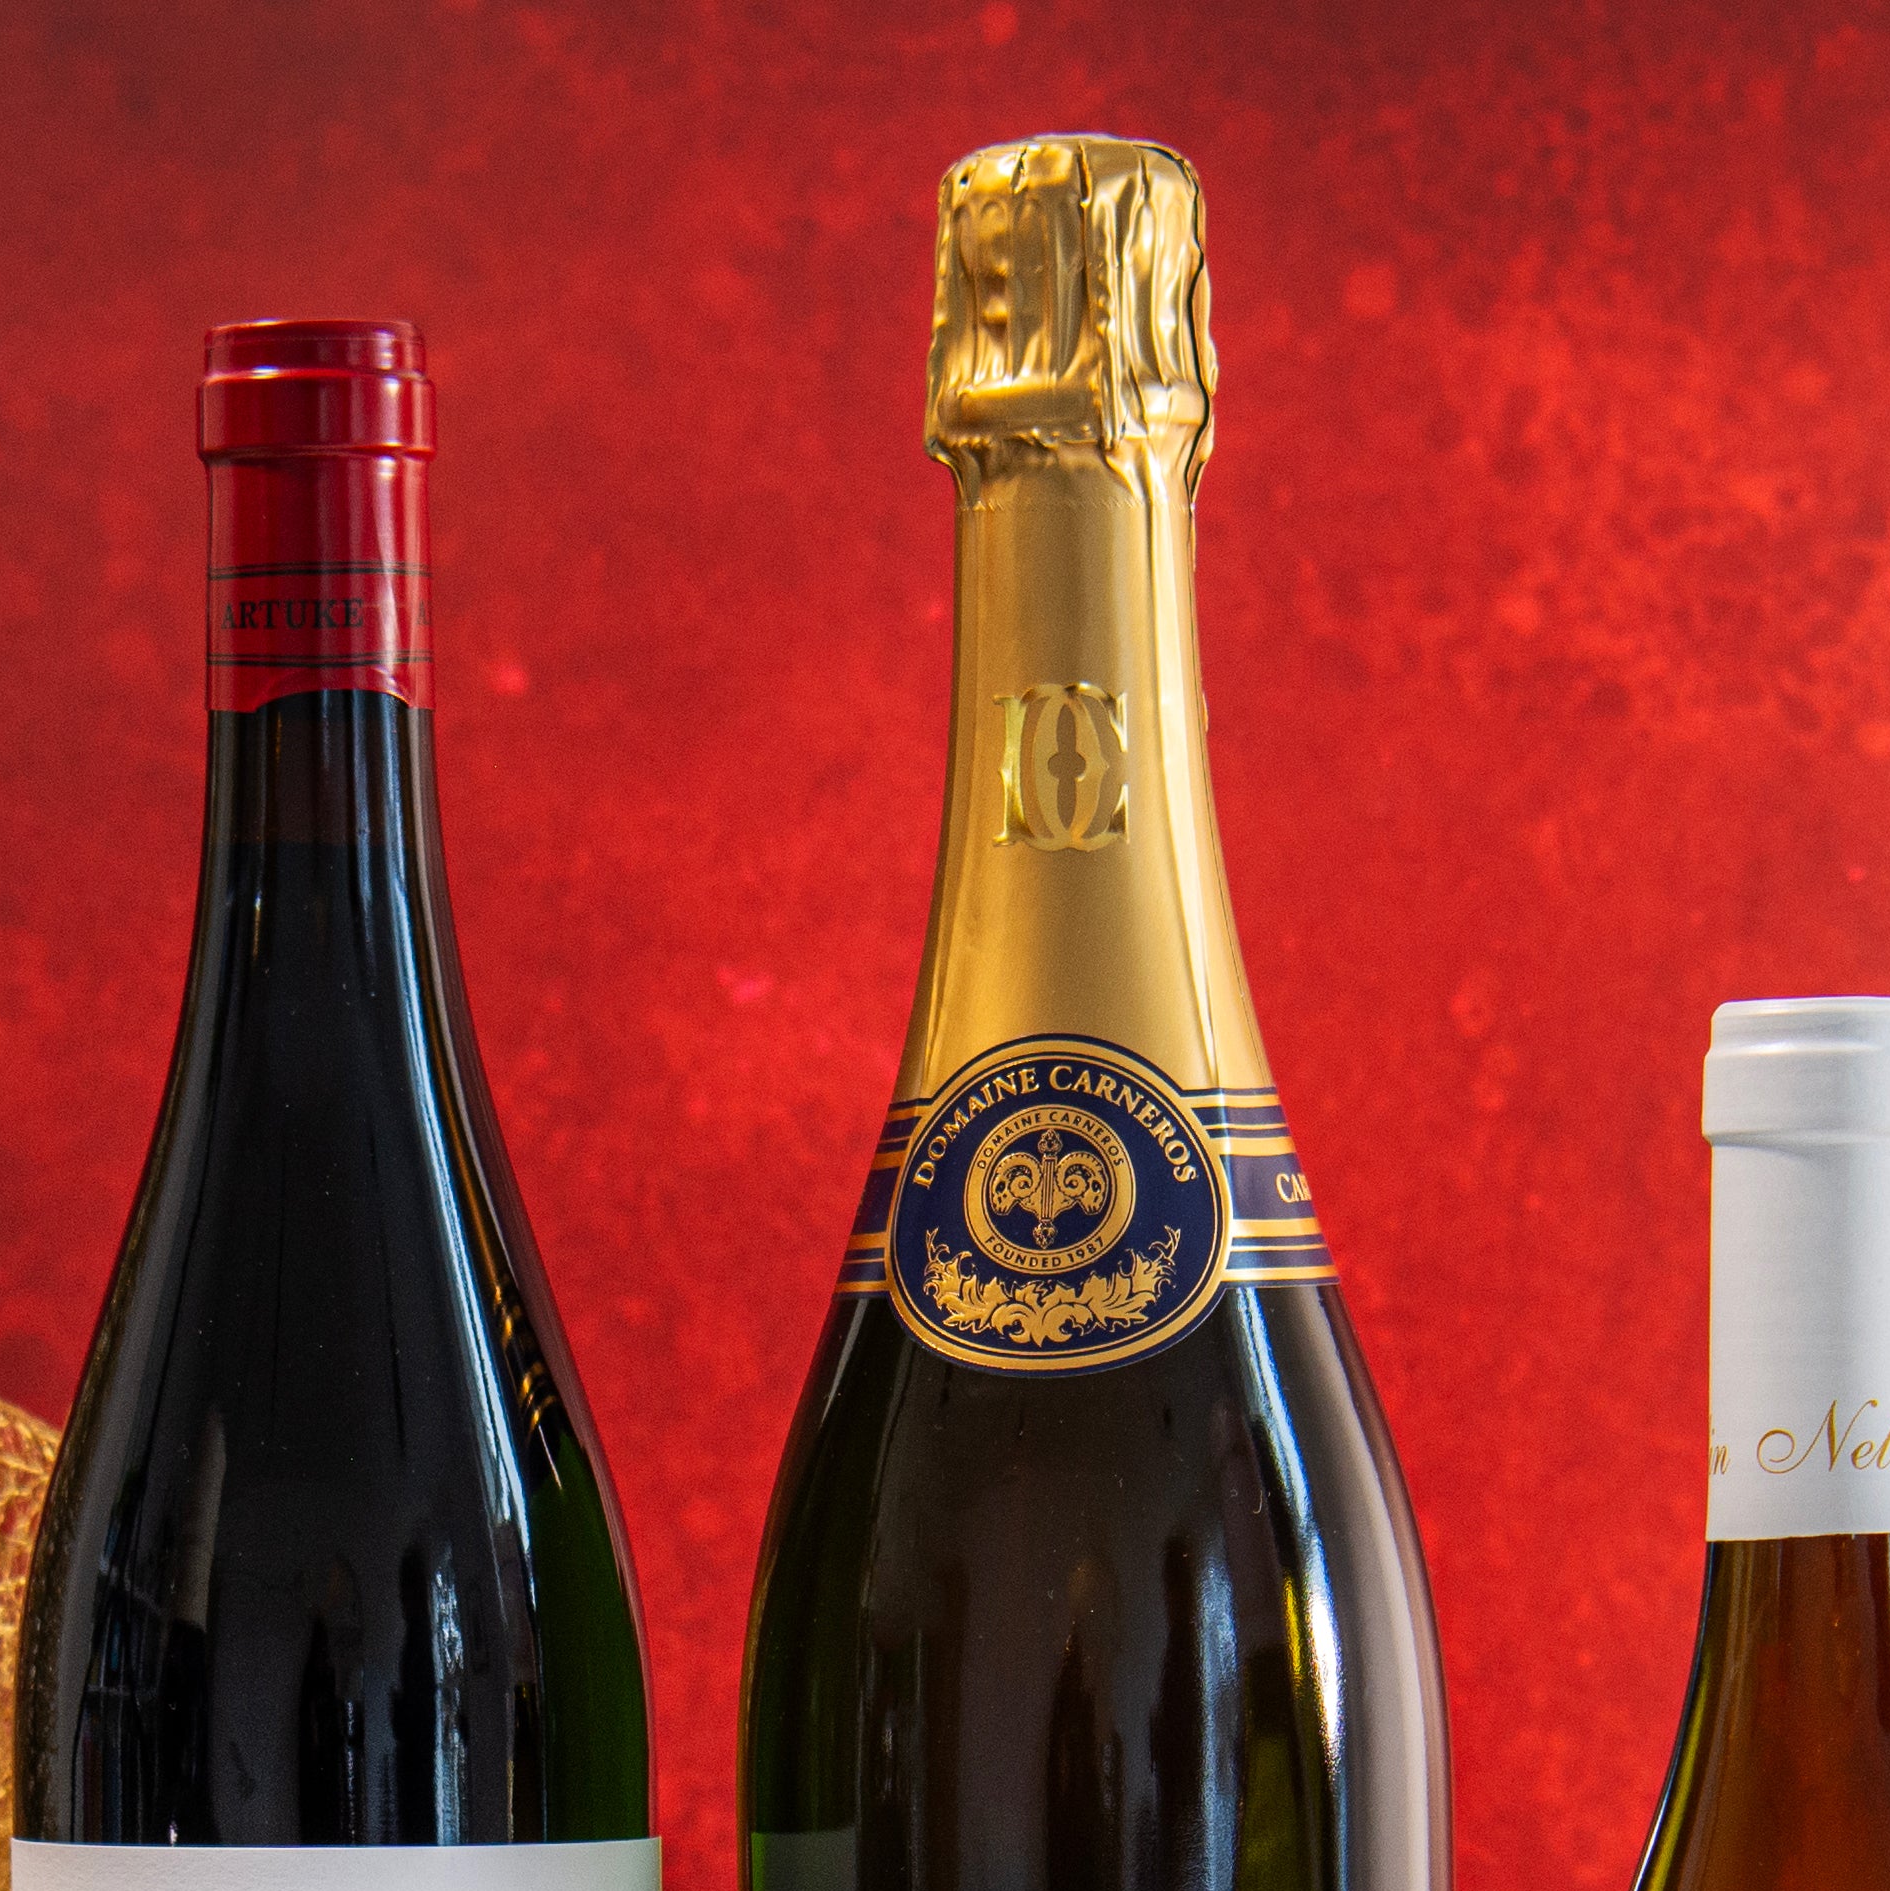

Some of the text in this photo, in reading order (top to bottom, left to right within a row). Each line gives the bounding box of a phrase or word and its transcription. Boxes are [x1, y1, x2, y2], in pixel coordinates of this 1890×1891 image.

[221, 598, 364, 630] ARTUKE
[912, 1065, 1199, 1190] DOMAINE CARNEROS
[977, 1111, 1125, 1169] DOMAINE CARNEROS
[985, 1236, 1104, 1268] FOUNDED 1987
